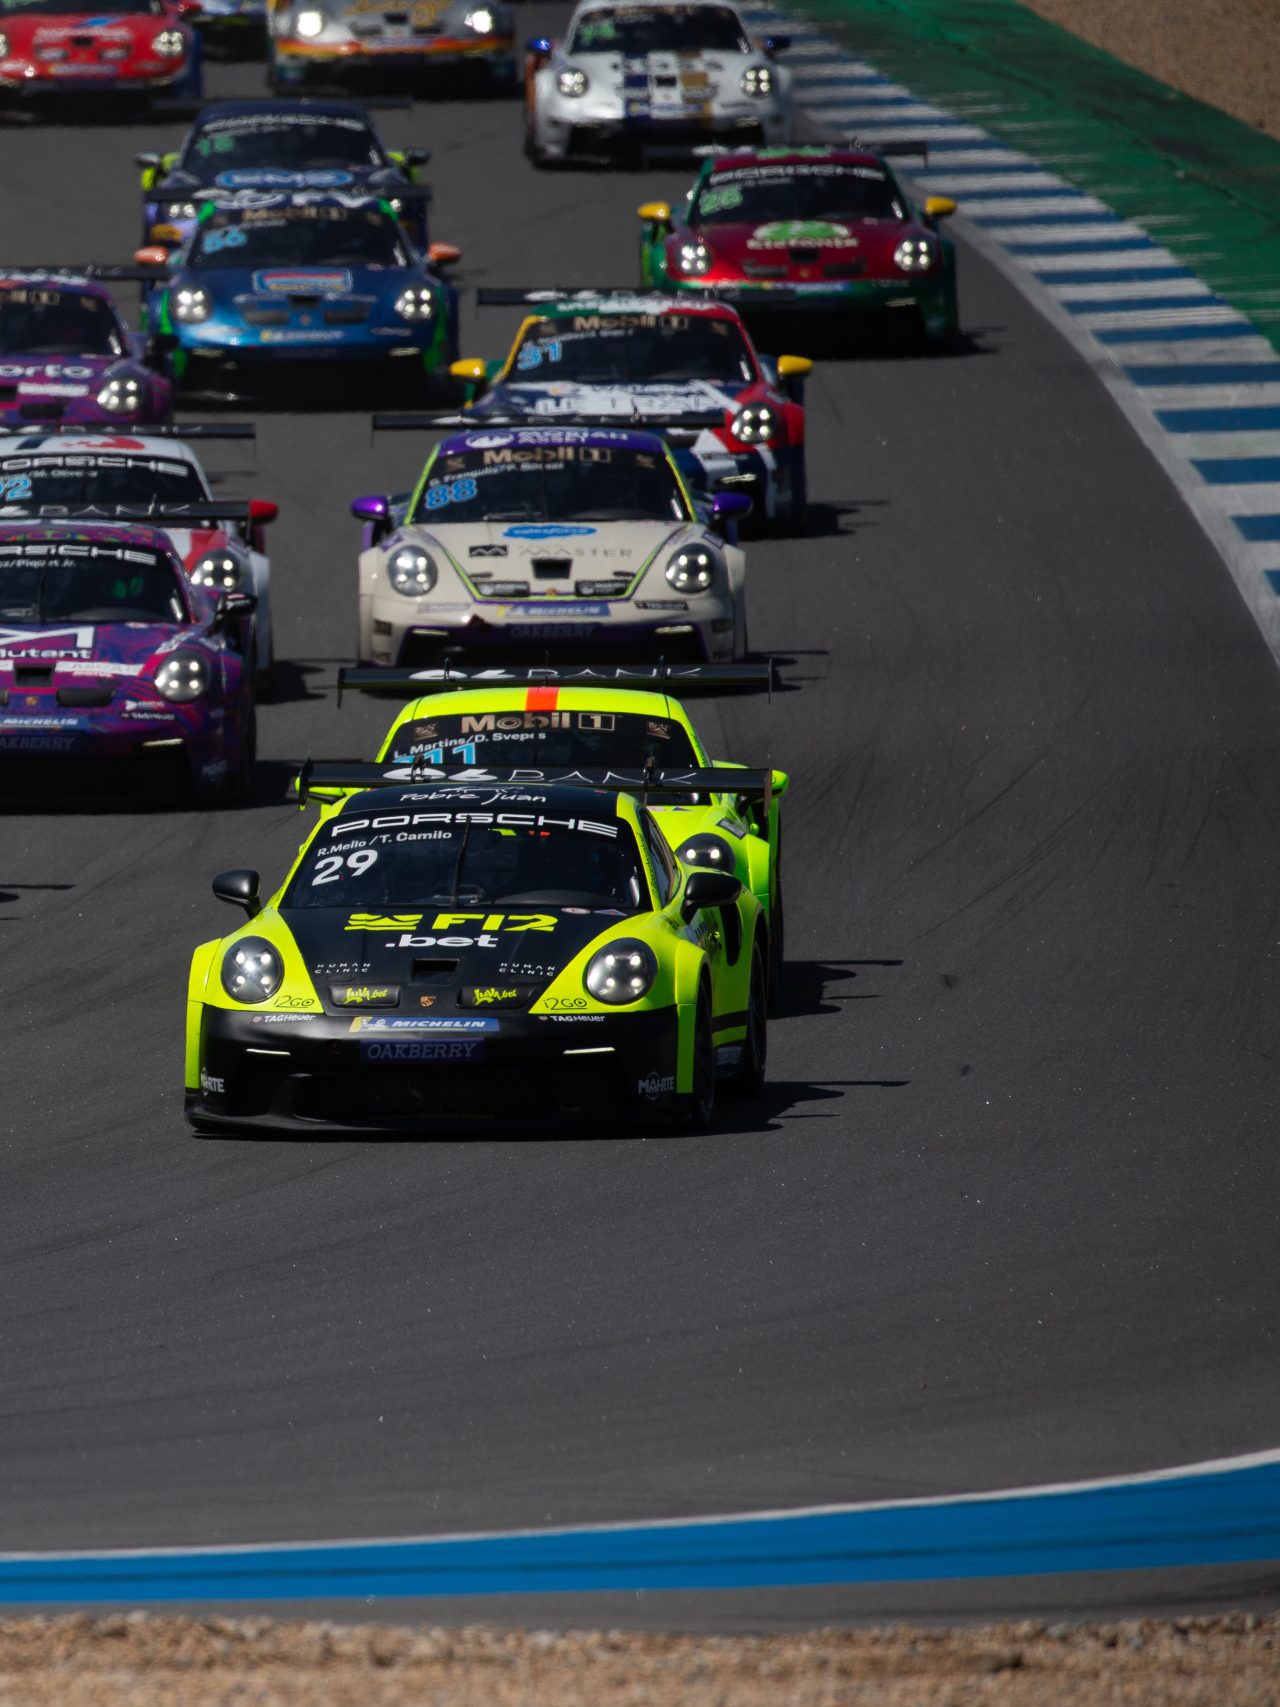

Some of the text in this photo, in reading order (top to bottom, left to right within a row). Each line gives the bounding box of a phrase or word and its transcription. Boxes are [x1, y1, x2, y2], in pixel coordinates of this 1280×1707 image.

[575, 316, 656, 331] Mobil
[483, 449, 575, 467] Mobil
[425, 479, 477, 511] 88
[3, 717, 78, 727] MICHELIN
[461, 713, 570, 733] Mobil
[393, 743, 477, 765] 11
[508, 770, 699, 785] BANK
[331, 813, 619, 838] PORSCHE
[397, 828, 452, 841] Camilo
[311, 849, 379, 886] 29
[431, 914, 559, 932] F12
[385, 934, 499, 948] .bet
[314, 967, 369, 975] CLINIC
[498, 967, 554, 977] CLINIC
[499, 962, 556, 971] HUMAN
[264, 1014, 316, 1024] TAGHeuer
[390, 1020, 486, 1029] MICHELIN
[549, 1014, 606, 1024] TAGHeuer
[368, 1043, 477, 1060] OAKBERRY
